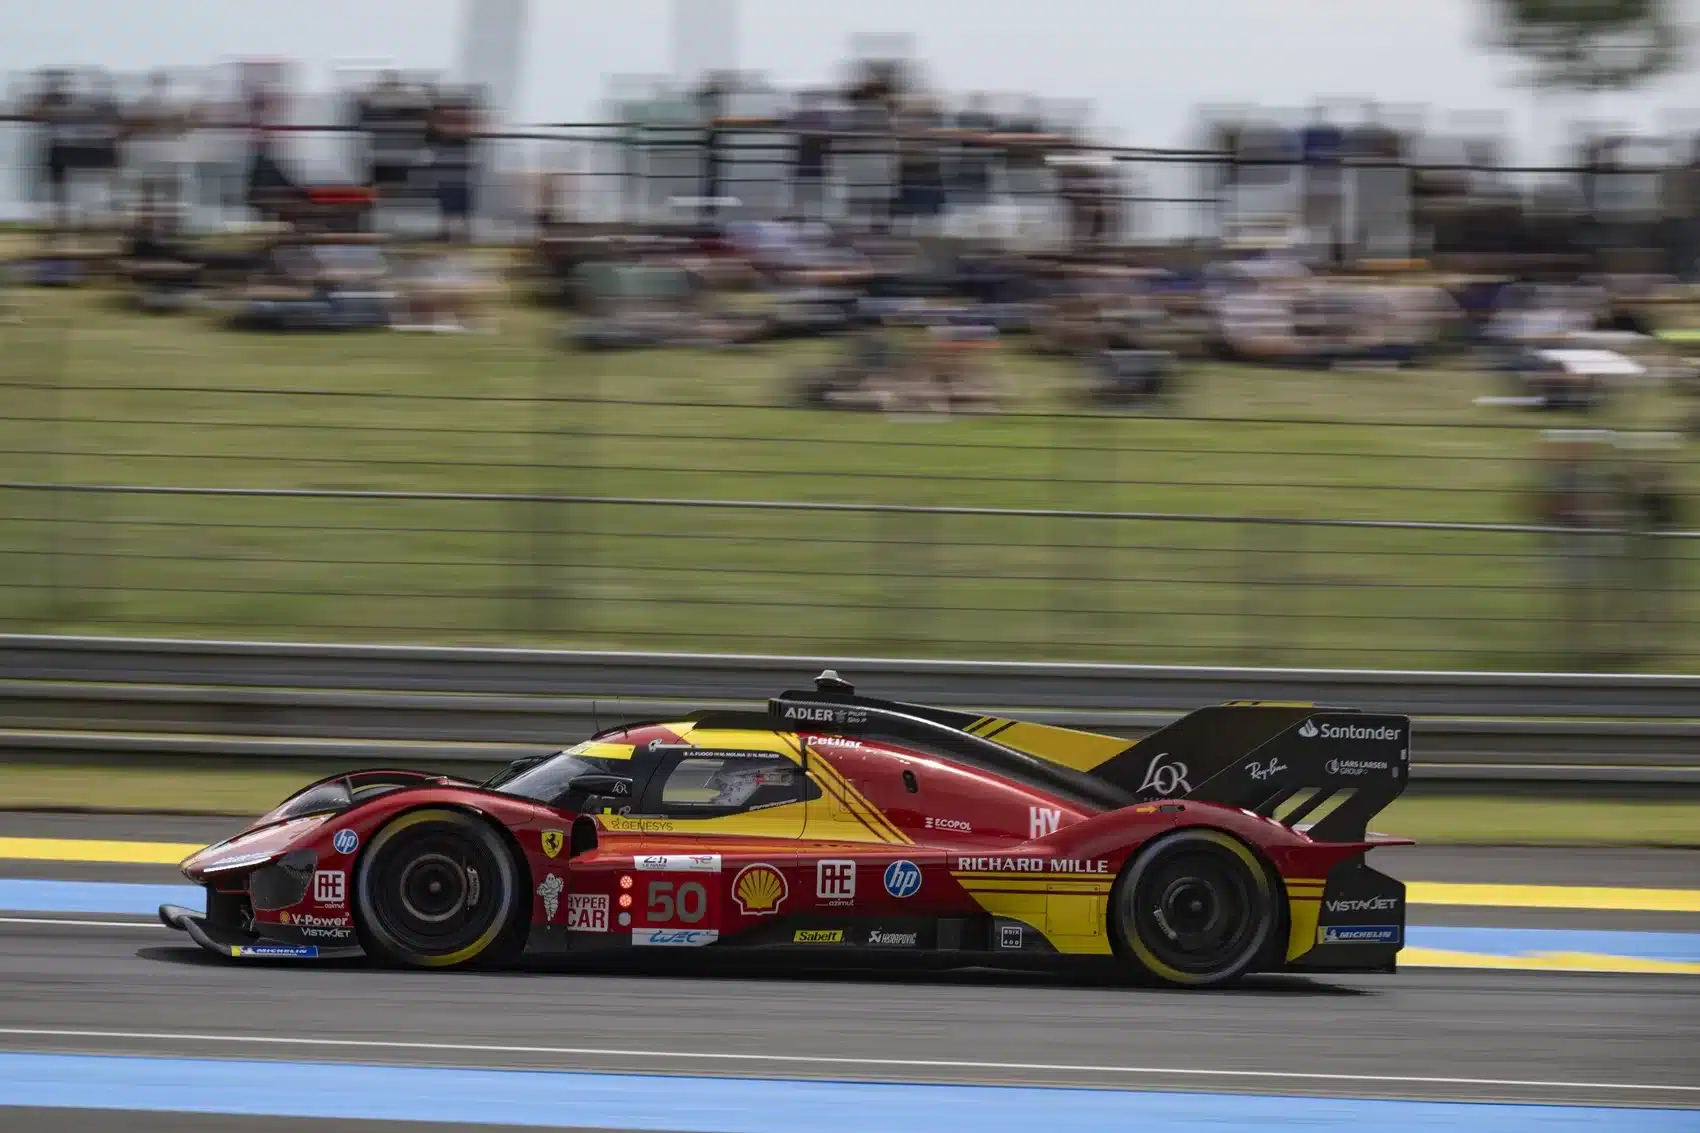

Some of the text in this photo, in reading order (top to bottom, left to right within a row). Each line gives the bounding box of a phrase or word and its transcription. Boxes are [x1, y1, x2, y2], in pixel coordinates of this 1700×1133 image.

[784, 707, 834, 721] ADLER
[1320, 723, 1401, 740] Santander
[1244, 757, 1288, 781] Ray-Ban
[1340, 760, 1388, 769] LARS LARSEN
[621, 820, 674, 831] GENESYS
[935, 818, 972, 831] ECOPOL
[336, 829, 356, 852] hp
[958, 857, 1109, 873] RICHARD MILLE
[888, 860, 918, 897] hp
[647, 881, 706, 923] 50
[828, 899, 855, 907] azimut
[292, 914, 348, 926] V-Power
[568, 908, 605, 929] CAR
[799, 931, 838, 941] Sabelt
